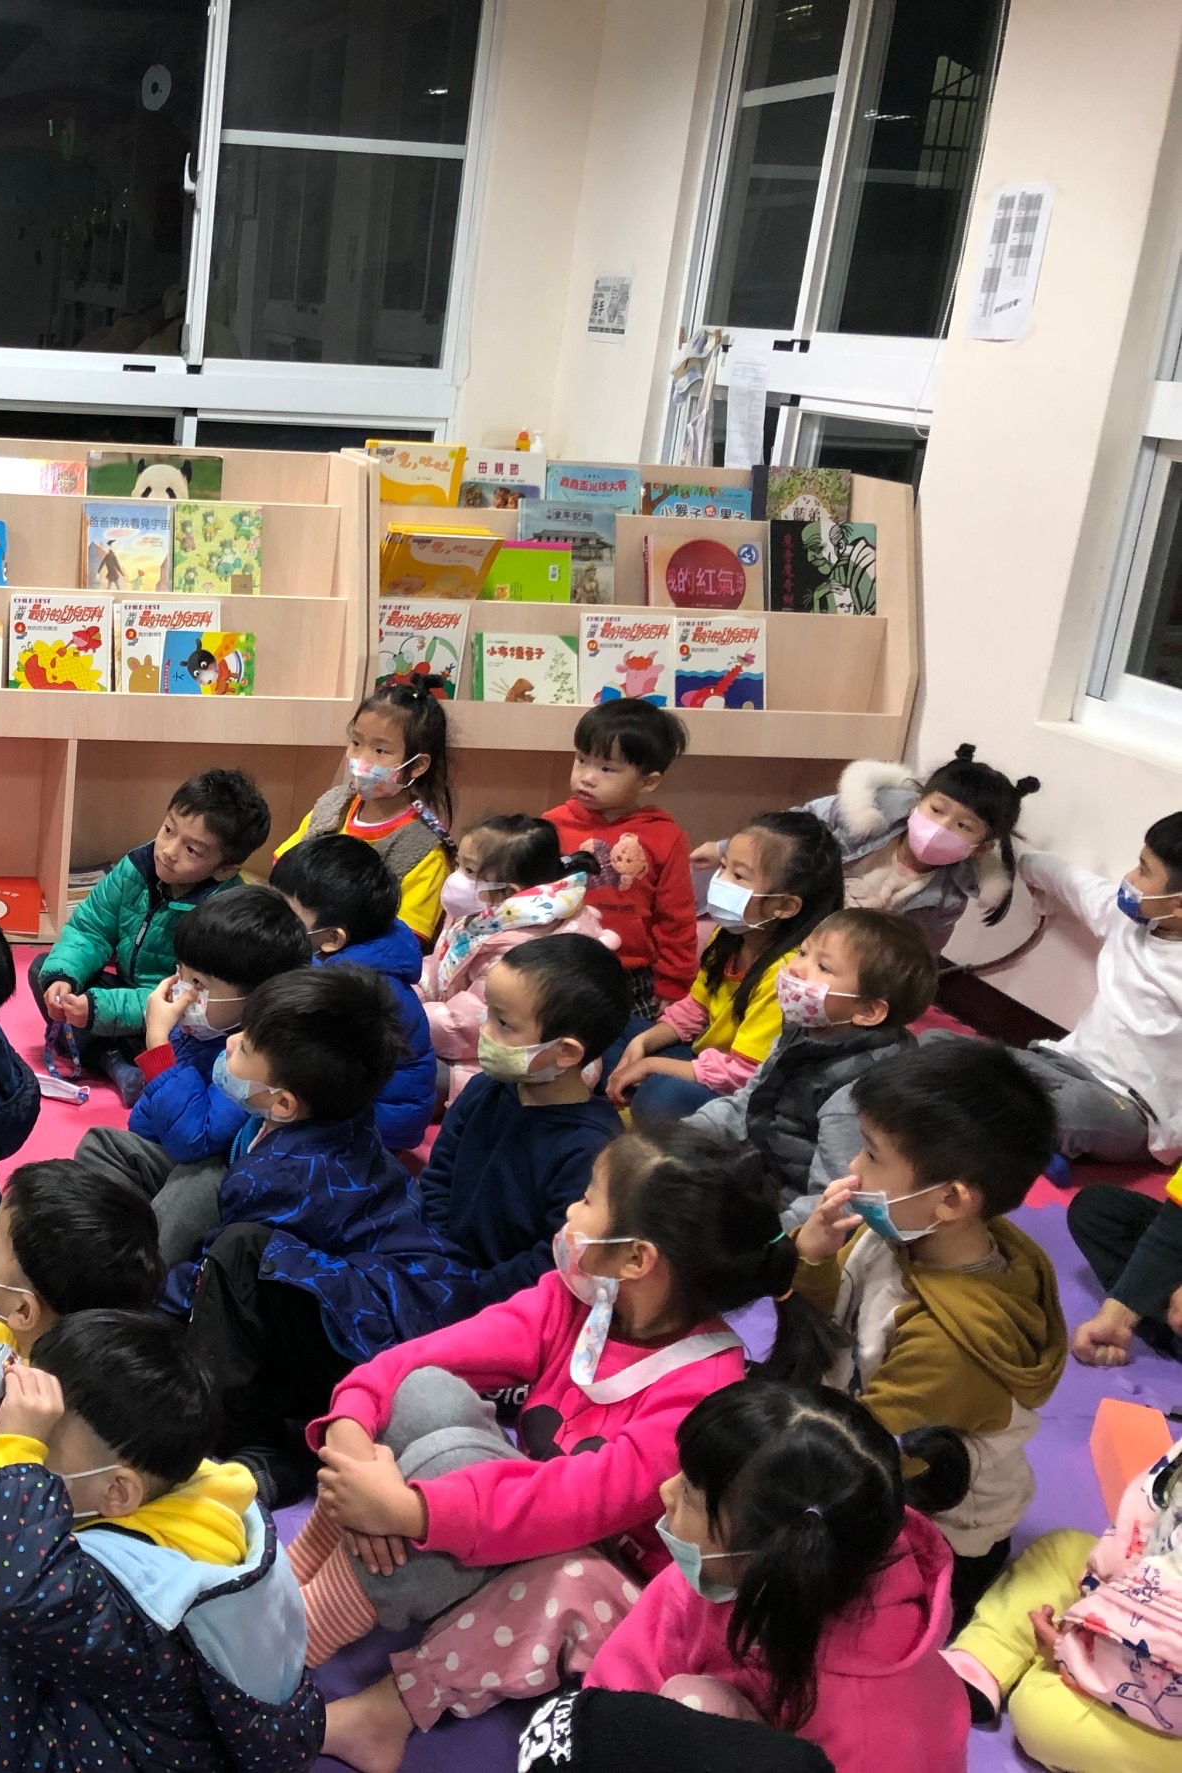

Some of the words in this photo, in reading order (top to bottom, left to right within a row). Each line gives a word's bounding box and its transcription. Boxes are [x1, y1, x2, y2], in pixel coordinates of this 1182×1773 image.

[89, 515, 171, 531] 爸爸帶我看見宇宙
